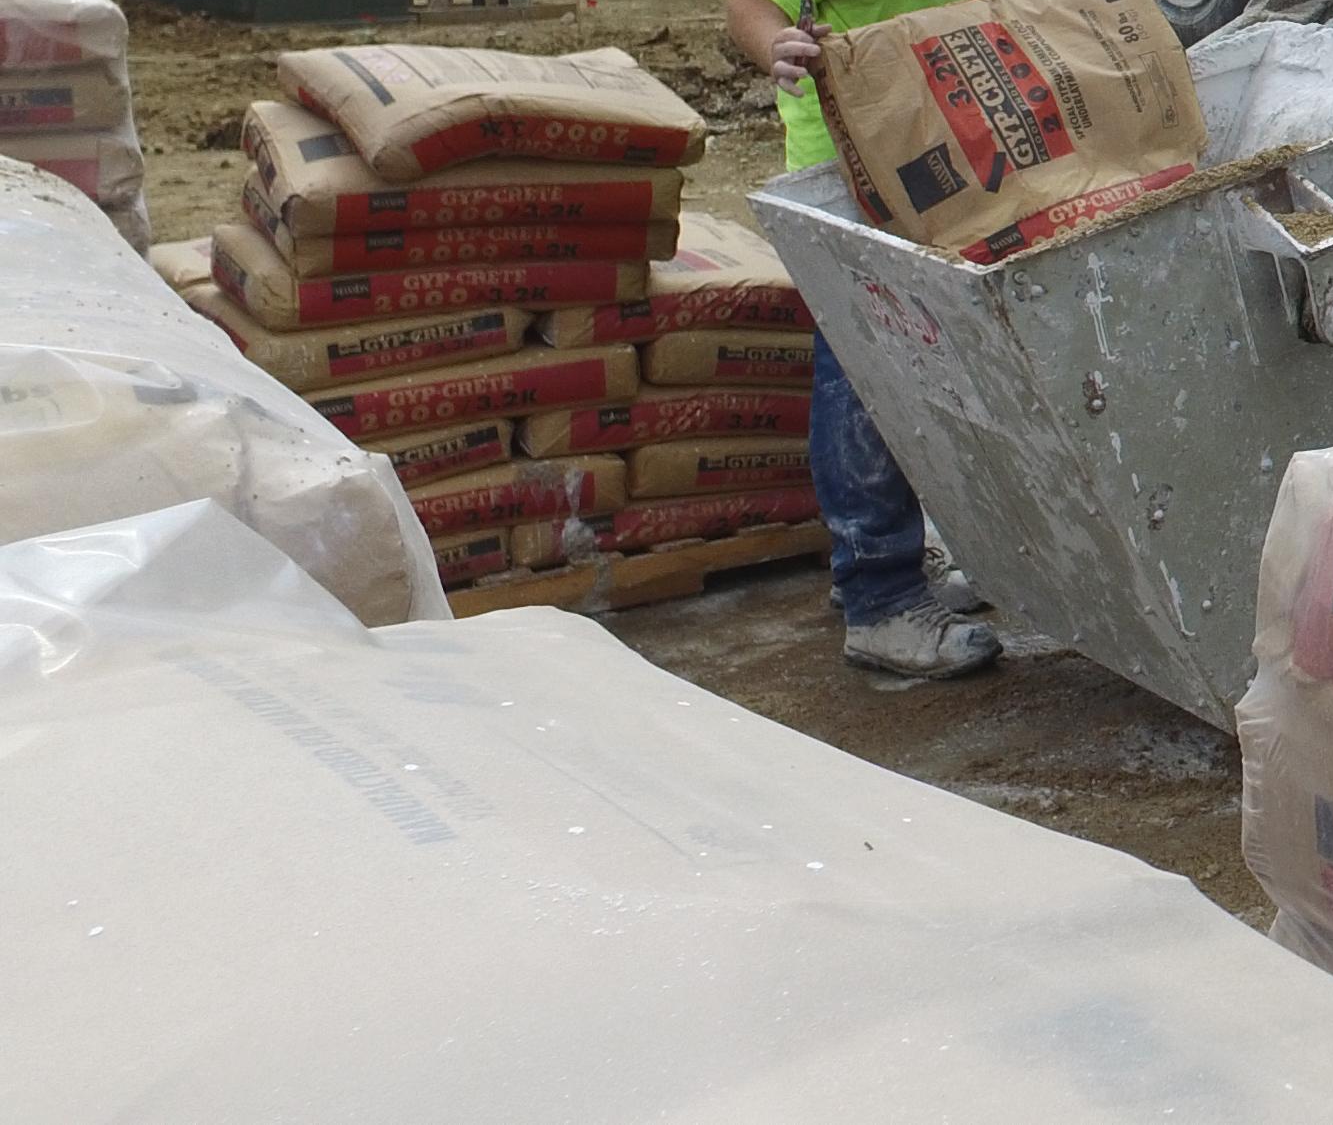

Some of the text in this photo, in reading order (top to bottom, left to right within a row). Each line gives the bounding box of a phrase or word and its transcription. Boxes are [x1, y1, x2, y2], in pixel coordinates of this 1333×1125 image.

[1117, 23, 1141, 46] 80
[922, 44, 972, 107] 3.2K
[943, 30, 1036, 165] GYP-CRETE
[971, 27, 1050, 163] FLOOR UNDERLAYMENT
[1058, 60, 1093, 130] UNDERLAYMENT
[1067, 105, 1086, 141] SPECIAL
[440, 187, 563, 206] GYP-CRETE
[1048, 180, 1145, 223] GYP-CRETE
[437, 227, 559, 243] GYP-CRETE
[403, 269, 527, 290] GYP-CRETE
[364, 321, 473, 352] GYP-CRETE
[747, 347, 814, 363] GYP-CRE
[388, 375, 515, 407] GYP-CRETE
[727, 455, 807, 469] GYP-CRET
